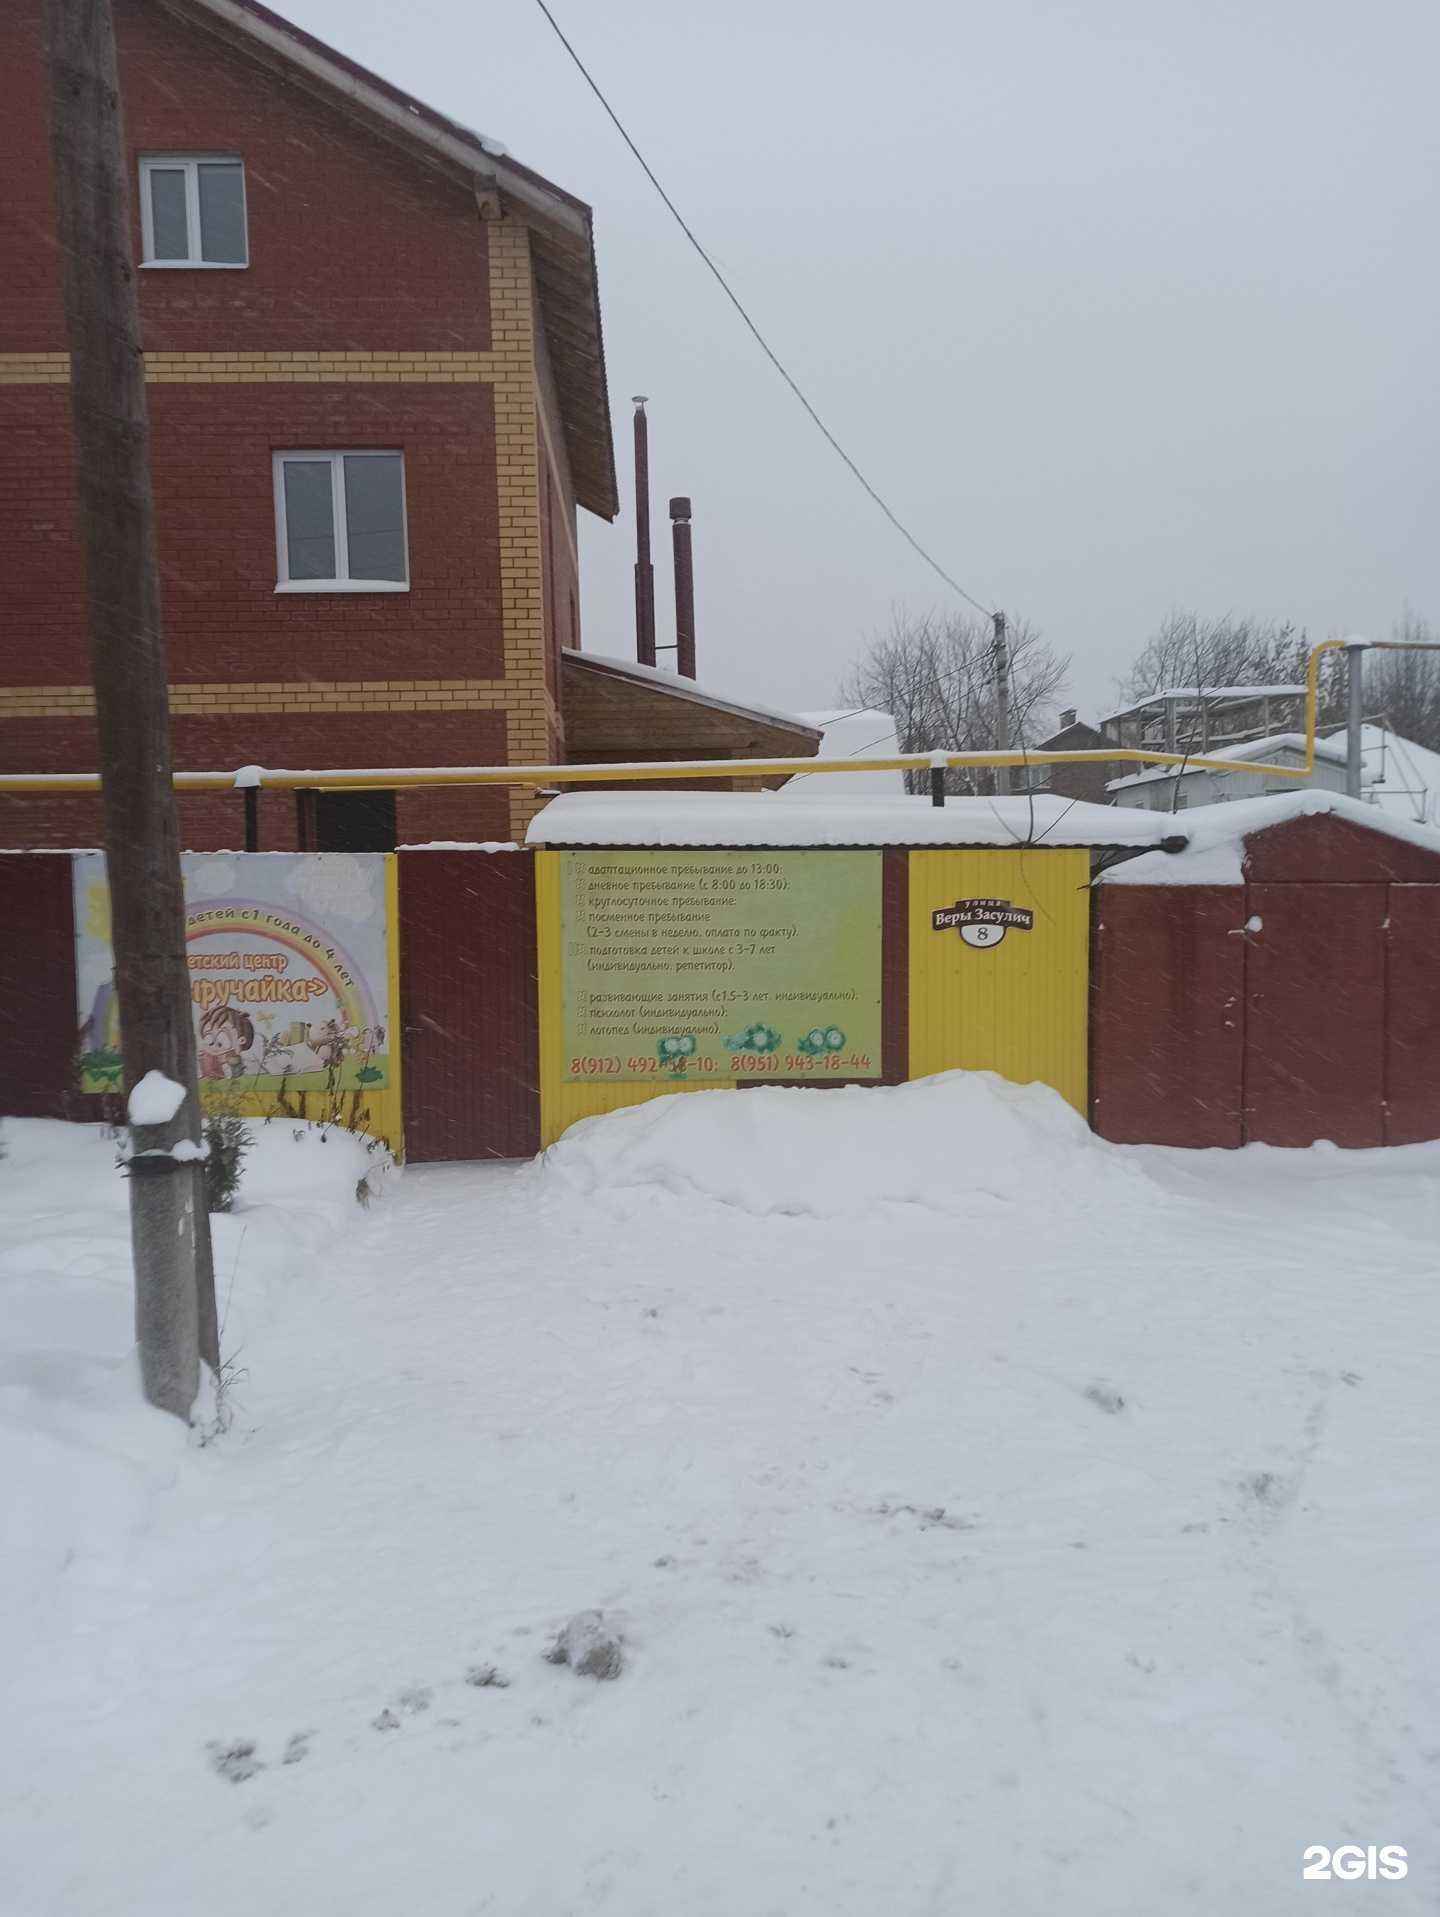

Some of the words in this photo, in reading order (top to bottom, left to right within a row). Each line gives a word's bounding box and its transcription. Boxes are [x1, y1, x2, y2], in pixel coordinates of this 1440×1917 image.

[671, 865, 733, 877] пребывание
[588, 881, 630, 891] дневное
[633, 881, 696, 892] пребывание
[712, 879, 736, 890] 8:00
[588, 897, 669, 909] круглосуточное
[588, 912, 645, 922] посменное
[648, 912, 711, 925] пребывание
[936, 911, 972, 926] Веры
[974, 908, 1030, 924] Засулич
[615, 928, 649, 938] смены
[705, 928, 740, 937] оплата
[744, 928, 757, 937] по
[977, 927, 989, 940] 8
[187, 907, 235, 926] детей
[265, 915, 300, 936] года
[304, 934, 321, 949] до
[325, 948, 336, 961] 4
[334, 964, 355, 988] лет
[589, 946, 648, 956] подготовка
[650, 945, 680, 955] детей
[693, 946, 725, 955] школе
[736, 943, 756, 955] 3-7
[187, 952, 240, 970] етский
[243, 953, 288, 974] центр
[590, 993, 664, 1004] развивающие
[667, 993, 709, 1002] занятия
[590, 1007, 636, 1018] психолог
[589, 1024, 630, 1035] логопед
[570, 1056, 621, 1073] 8(912)
[730, 1055, 779, 1072] 8(951)
[785, 1054, 872, 1071] 943-18-44
